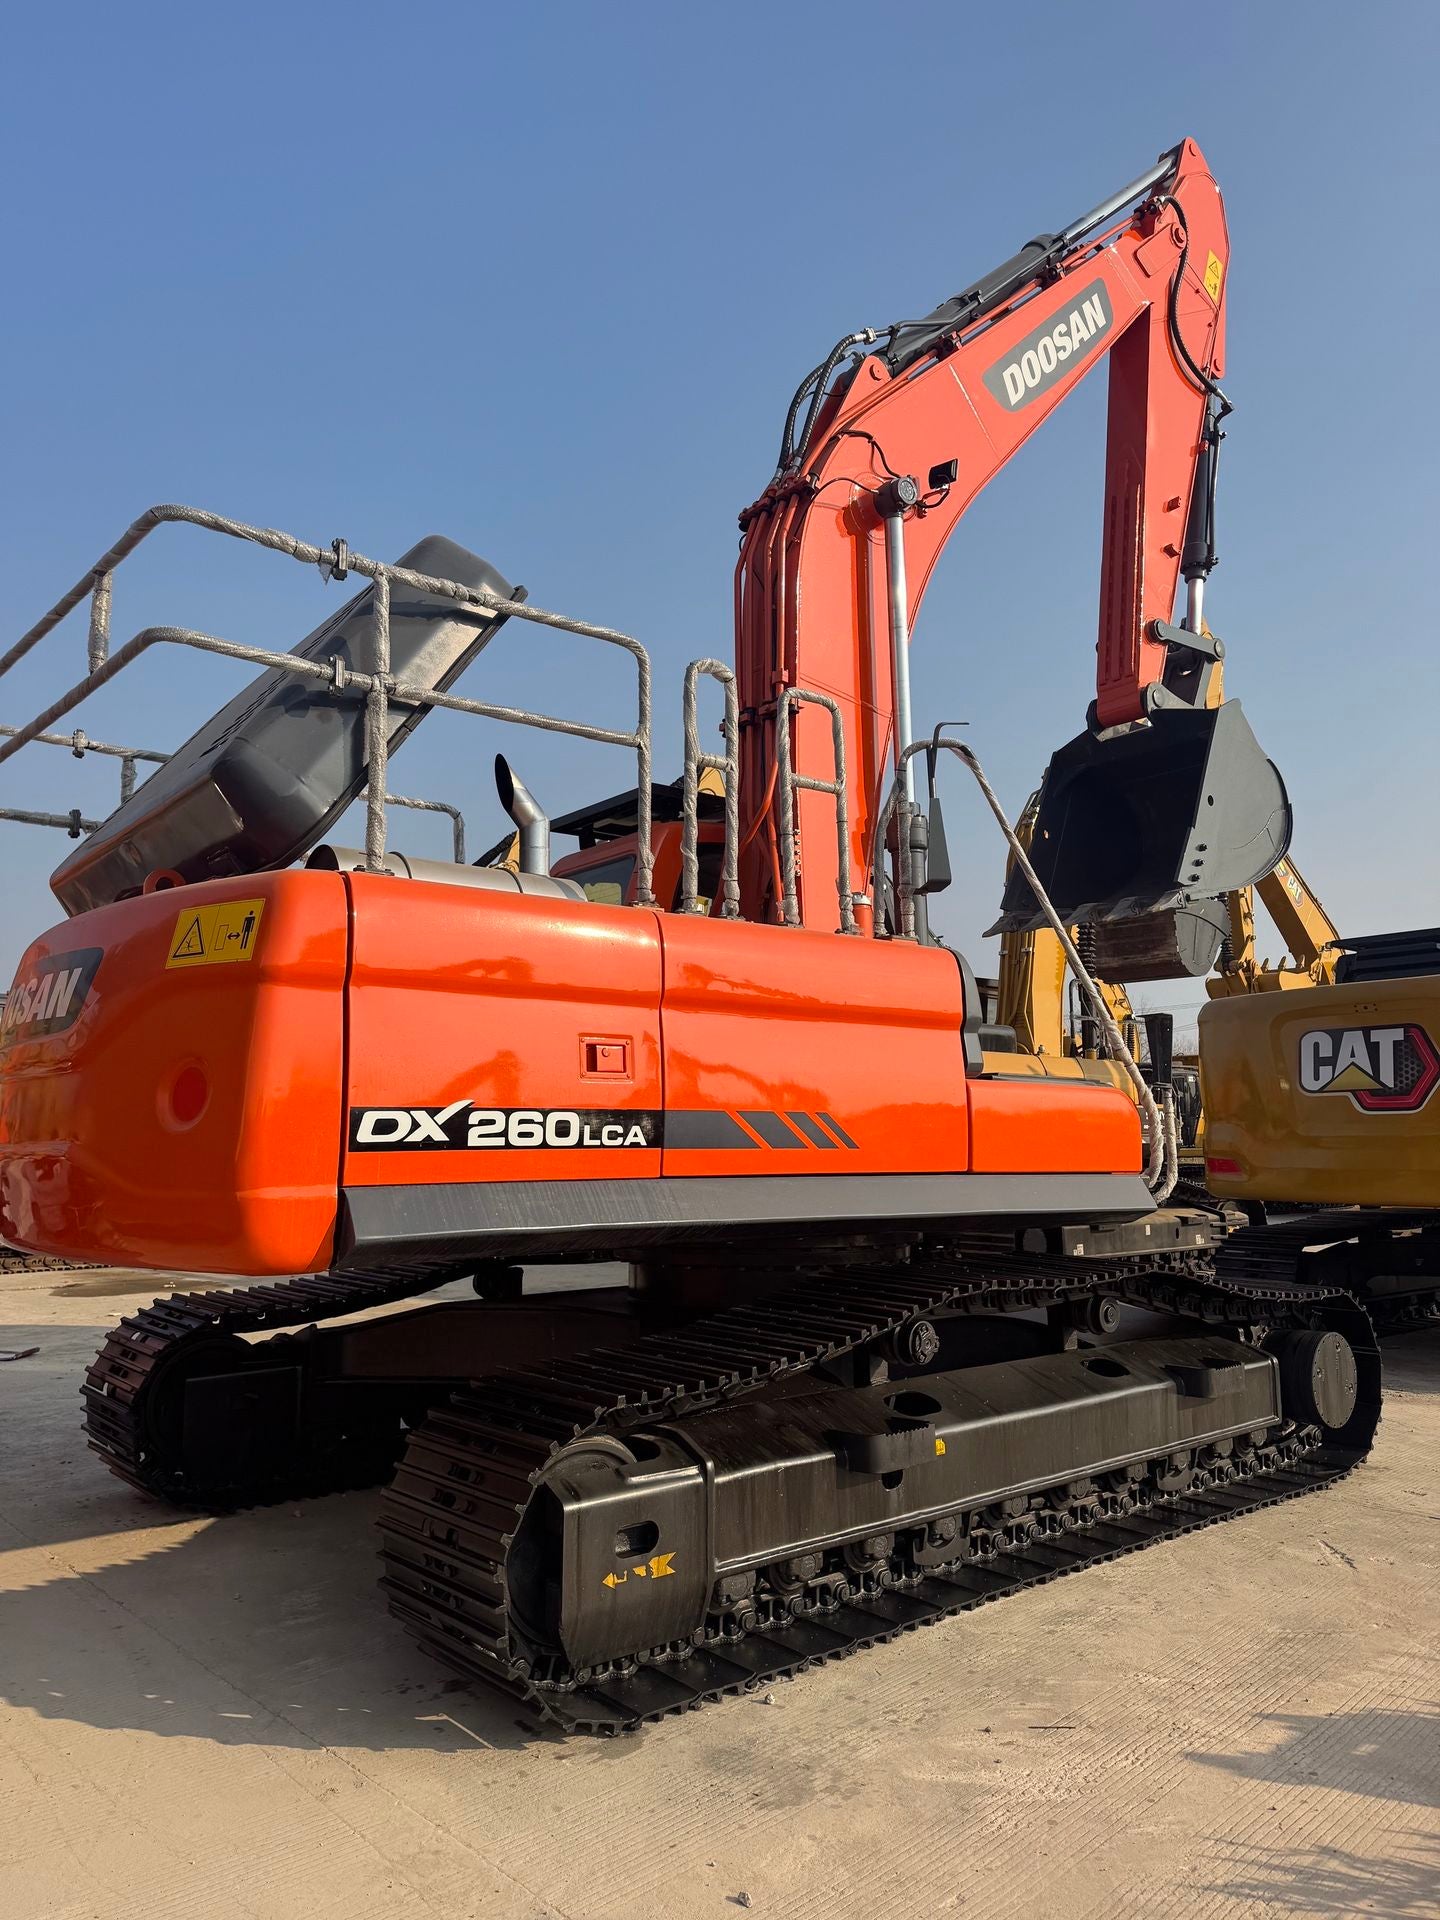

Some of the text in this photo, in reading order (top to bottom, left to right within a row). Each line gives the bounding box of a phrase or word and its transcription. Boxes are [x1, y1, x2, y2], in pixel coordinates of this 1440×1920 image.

[1002, 292, 1107, 407] DOOSAN
[1287, 874, 1302, 901] CAT
[1301, 1027, 1405, 1091] CAT
